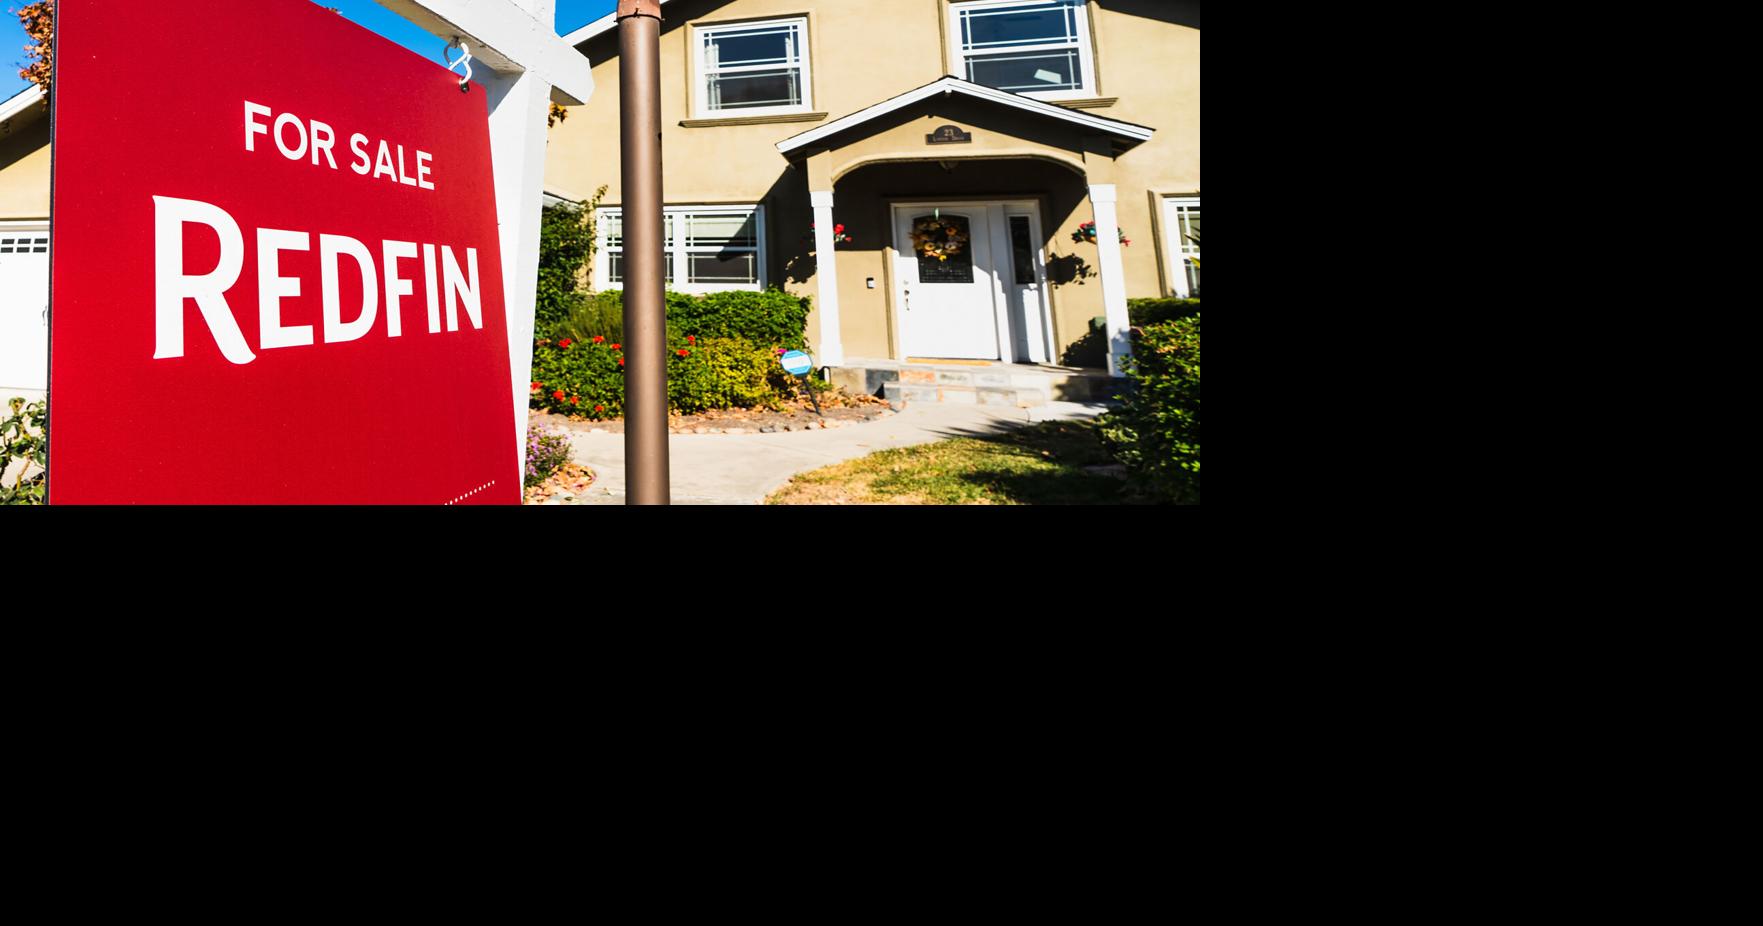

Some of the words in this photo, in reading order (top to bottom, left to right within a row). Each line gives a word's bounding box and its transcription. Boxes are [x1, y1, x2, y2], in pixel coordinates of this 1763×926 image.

[244, 100, 338, 170] FOR
[349, 132, 435, 191] SALE
[152, 194, 483, 365] REDFIN
